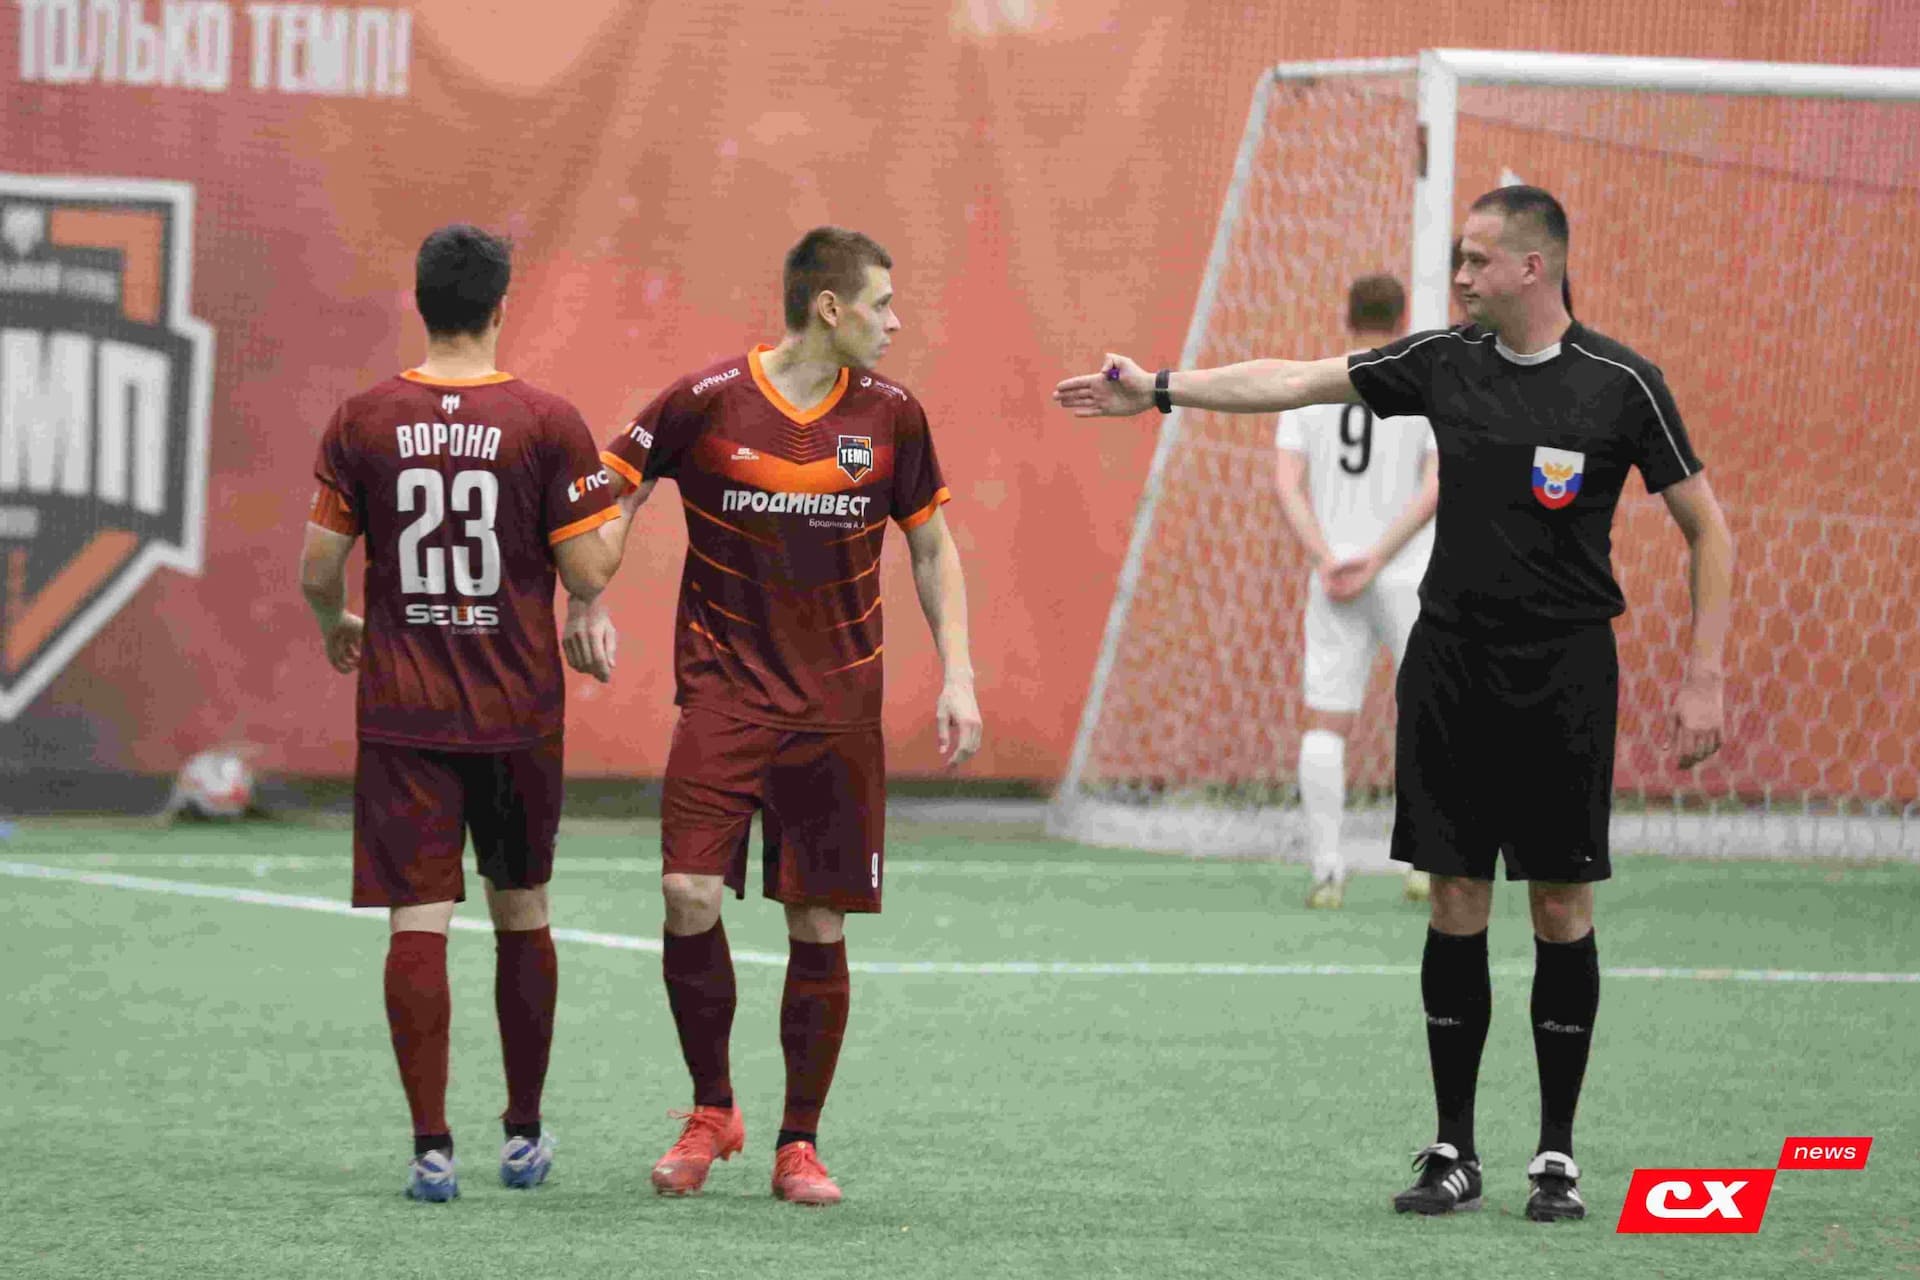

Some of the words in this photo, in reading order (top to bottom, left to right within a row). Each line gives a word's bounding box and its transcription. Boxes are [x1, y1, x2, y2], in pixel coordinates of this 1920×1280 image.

[20, 0, 232, 90] ТОЛЬКО
[247, 6, 412, 96] ТЕМП!
[396, 422, 501, 461] ВОРОНА
[1340, 402, 1372, 475] 9
[840, 448, 870, 467] ТЕМП
[722, 489, 871, 518] ПРОДИНВЕСТ
[397, 468, 500, 597] 23
[405, 604, 499, 626] SEUS
[871, 852, 879, 888] 9
